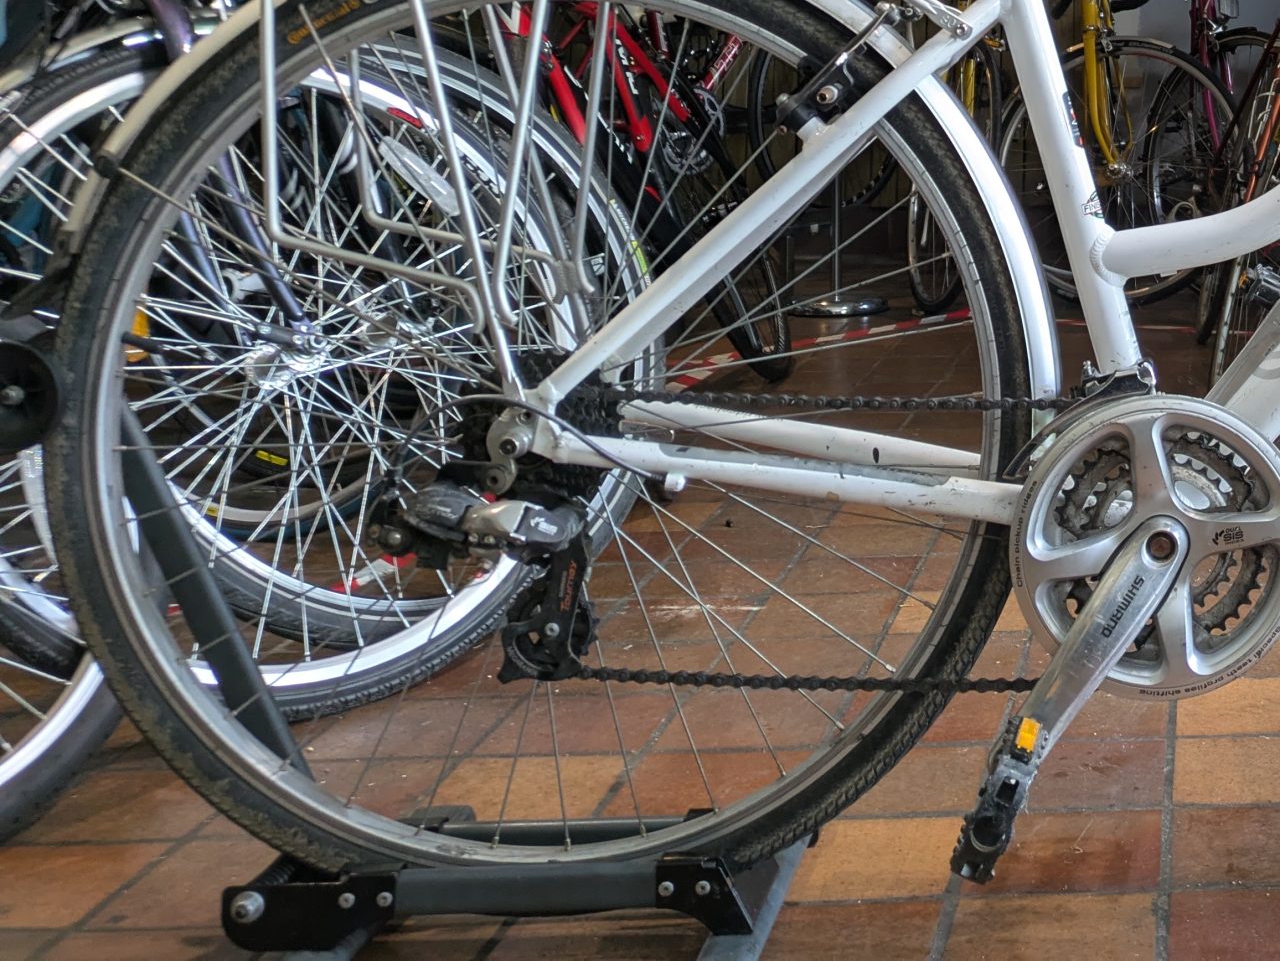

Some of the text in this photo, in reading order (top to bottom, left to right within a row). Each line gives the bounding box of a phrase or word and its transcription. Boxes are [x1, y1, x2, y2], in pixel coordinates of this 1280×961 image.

[1014, 480, 1038, 588] Chain pickup ridges
[1101, 574, 1145, 638] SHIMANO
[1226, 657, 1253, 678] teeth
[1138, 688, 1182, 698] shifting
[1184, 676, 1225, 693] profiles
